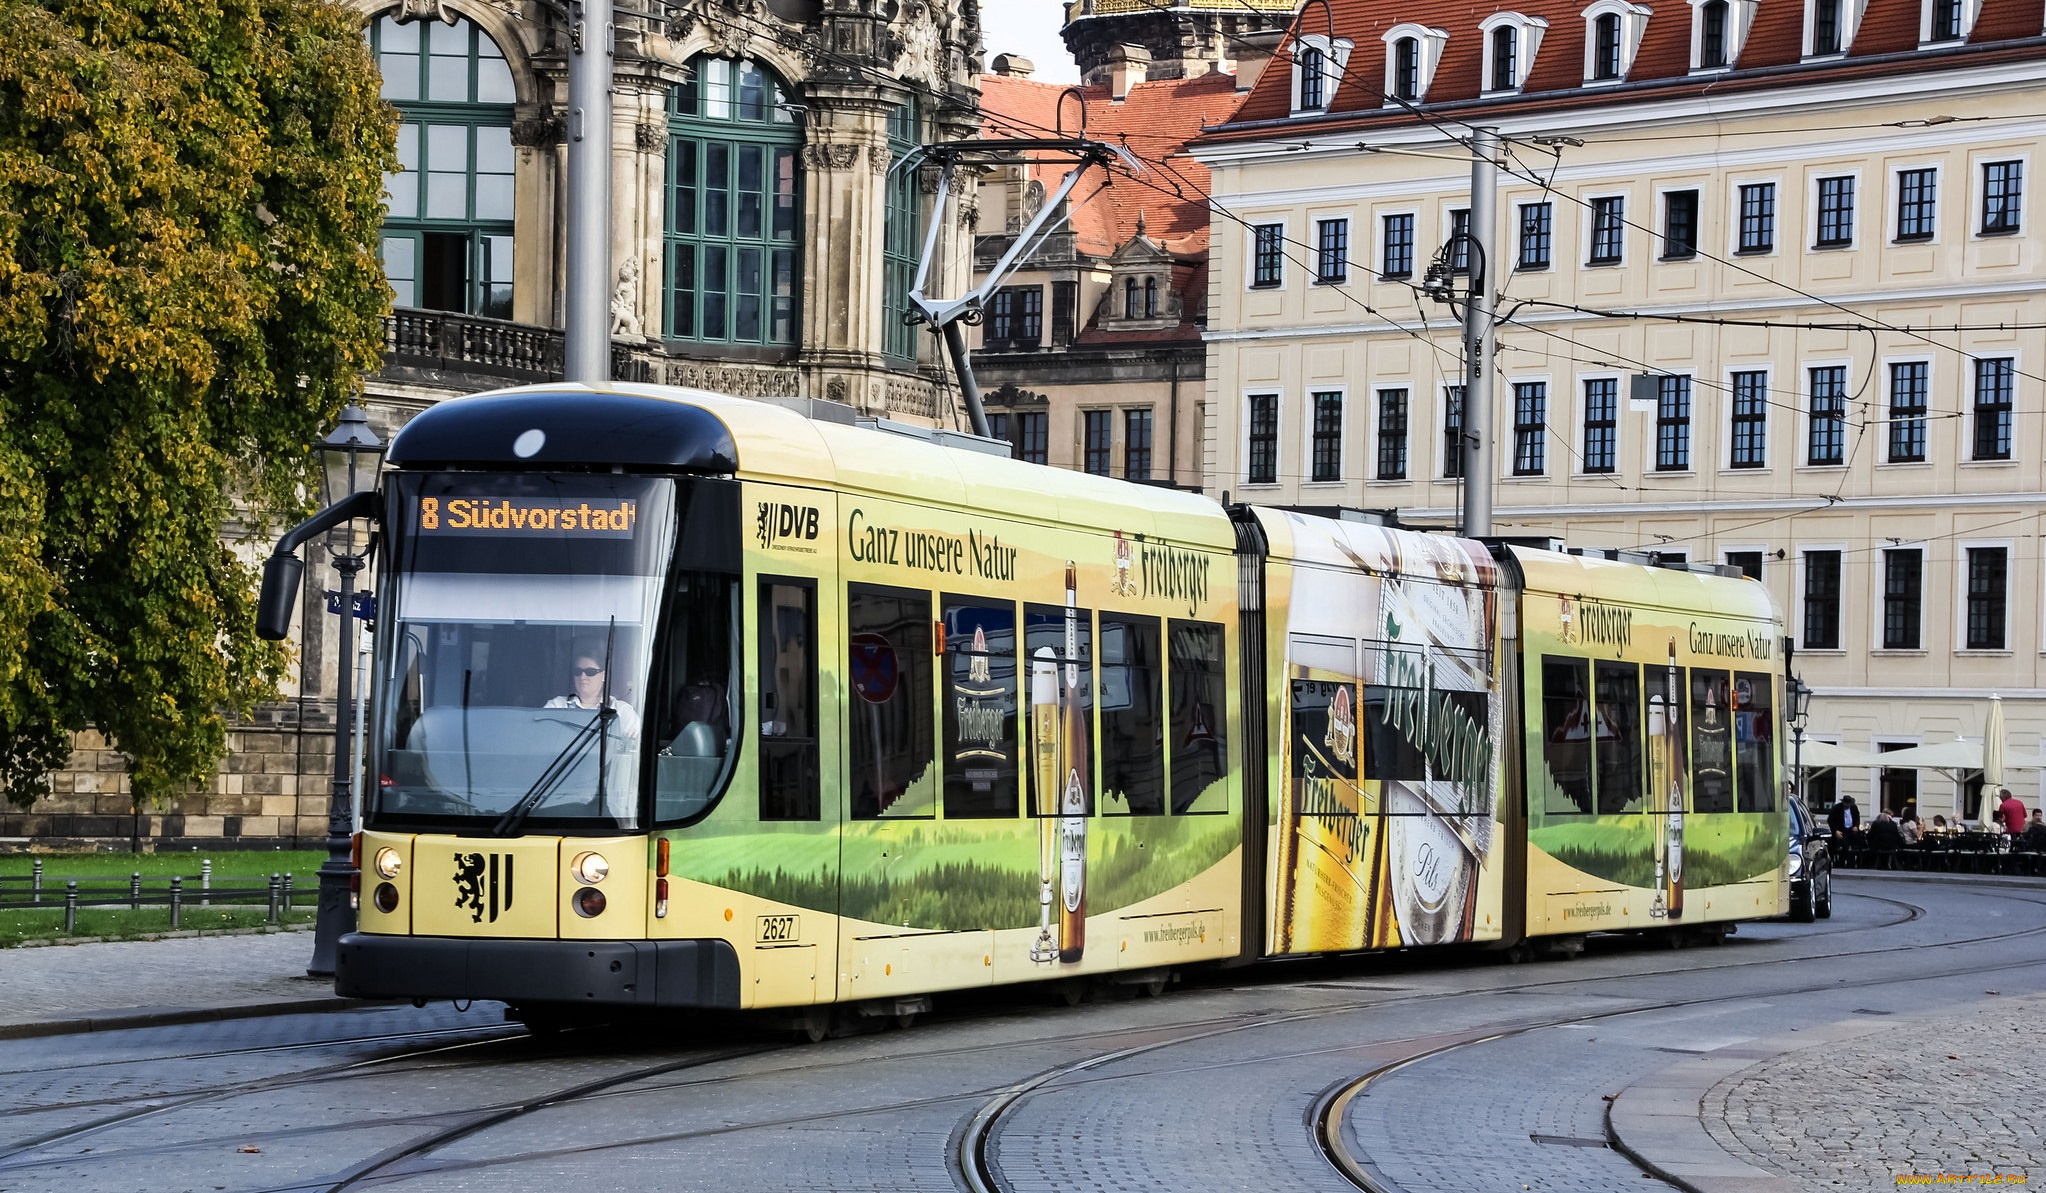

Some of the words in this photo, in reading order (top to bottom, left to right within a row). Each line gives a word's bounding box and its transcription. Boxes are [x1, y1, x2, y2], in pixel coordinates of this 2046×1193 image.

[422, 497, 439, 530] 8
[779, 503, 820, 540] DVB
[848, 508, 899, 566] Ganz
[905, 531, 963, 576] unsere
[969, 527, 1017, 582] Natur
[1134, 532, 1210, 618] Freiberger
[1574, 592, 1633, 659] Freiberger
[1689, 621, 1714, 655] Ganz
[1716, 632, 1745, 659] unsere
[1747, 628, 1772, 660] Natur
[1382, 610, 1494, 820] Freiberger
[1303, 753, 1371, 864] Freiberger
[1412, 842, 1439, 891] Pils
[763, 917, 794, 940] 2627
[1143, 919, 1206, 946] www.freibergerpils.de
